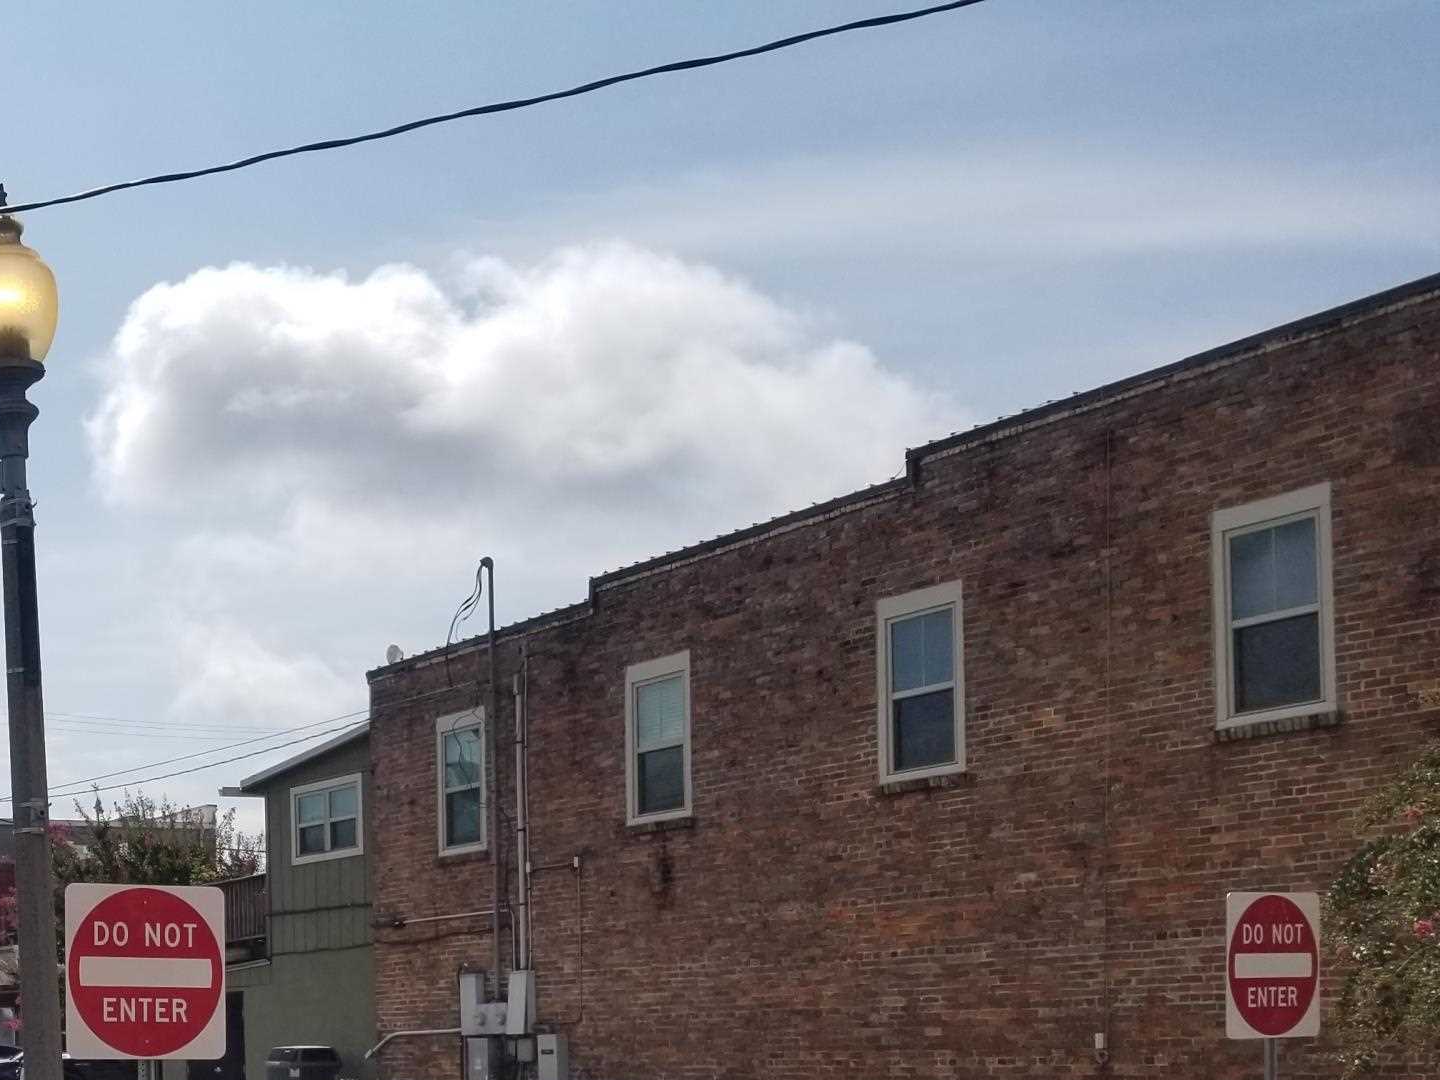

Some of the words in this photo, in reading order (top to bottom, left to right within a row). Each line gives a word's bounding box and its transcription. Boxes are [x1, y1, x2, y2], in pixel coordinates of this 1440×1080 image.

[93, 921, 129, 947] DO
[144, 922, 197, 948] NOT
[1242, 923, 1263, 945] DO
[1272, 923, 1304, 945] NOT
[1247, 986, 1298, 1008] ENTER
[103, 997, 188, 1023] ENTER
